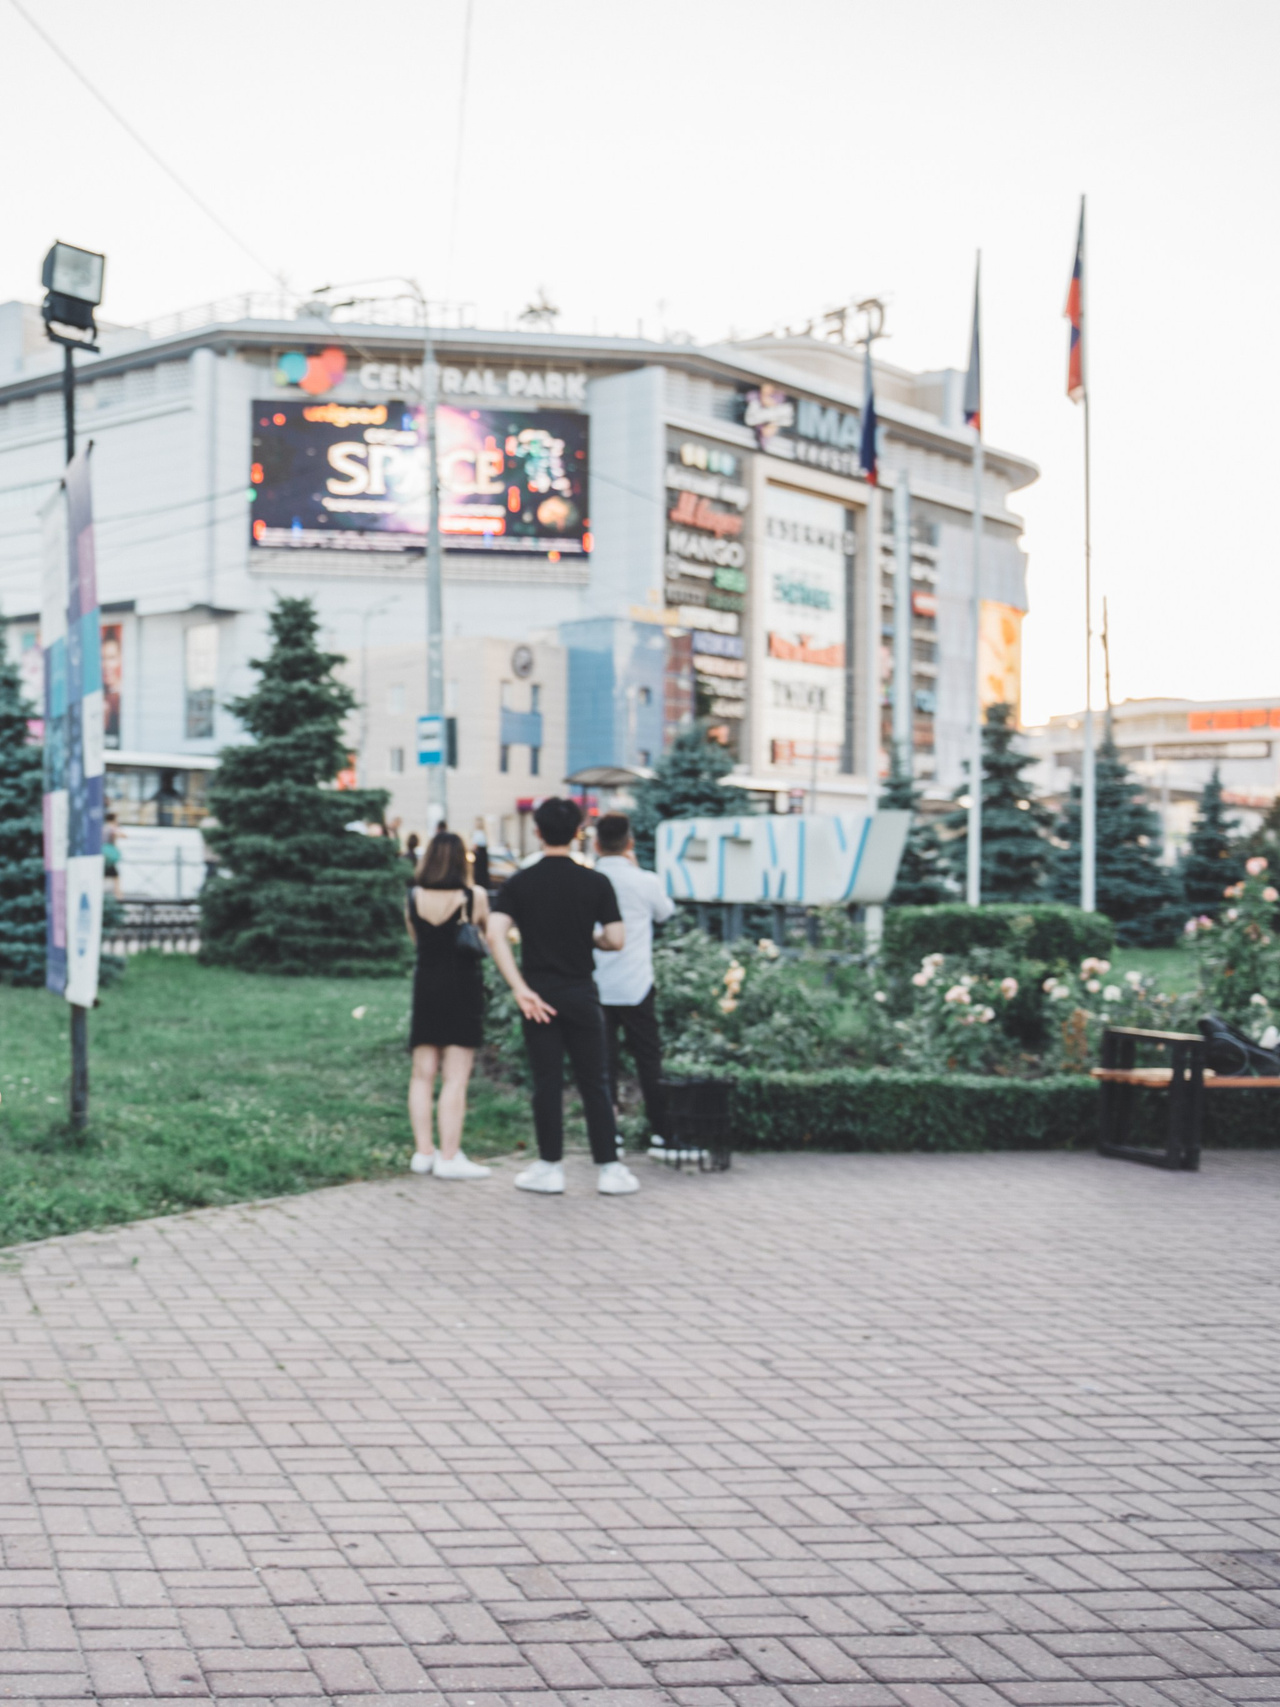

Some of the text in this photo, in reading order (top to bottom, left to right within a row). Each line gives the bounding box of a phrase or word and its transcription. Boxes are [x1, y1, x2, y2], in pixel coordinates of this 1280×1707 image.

[359, 362, 587, 400] CENRAL PARK
[668, 529, 746, 567] MANGO
